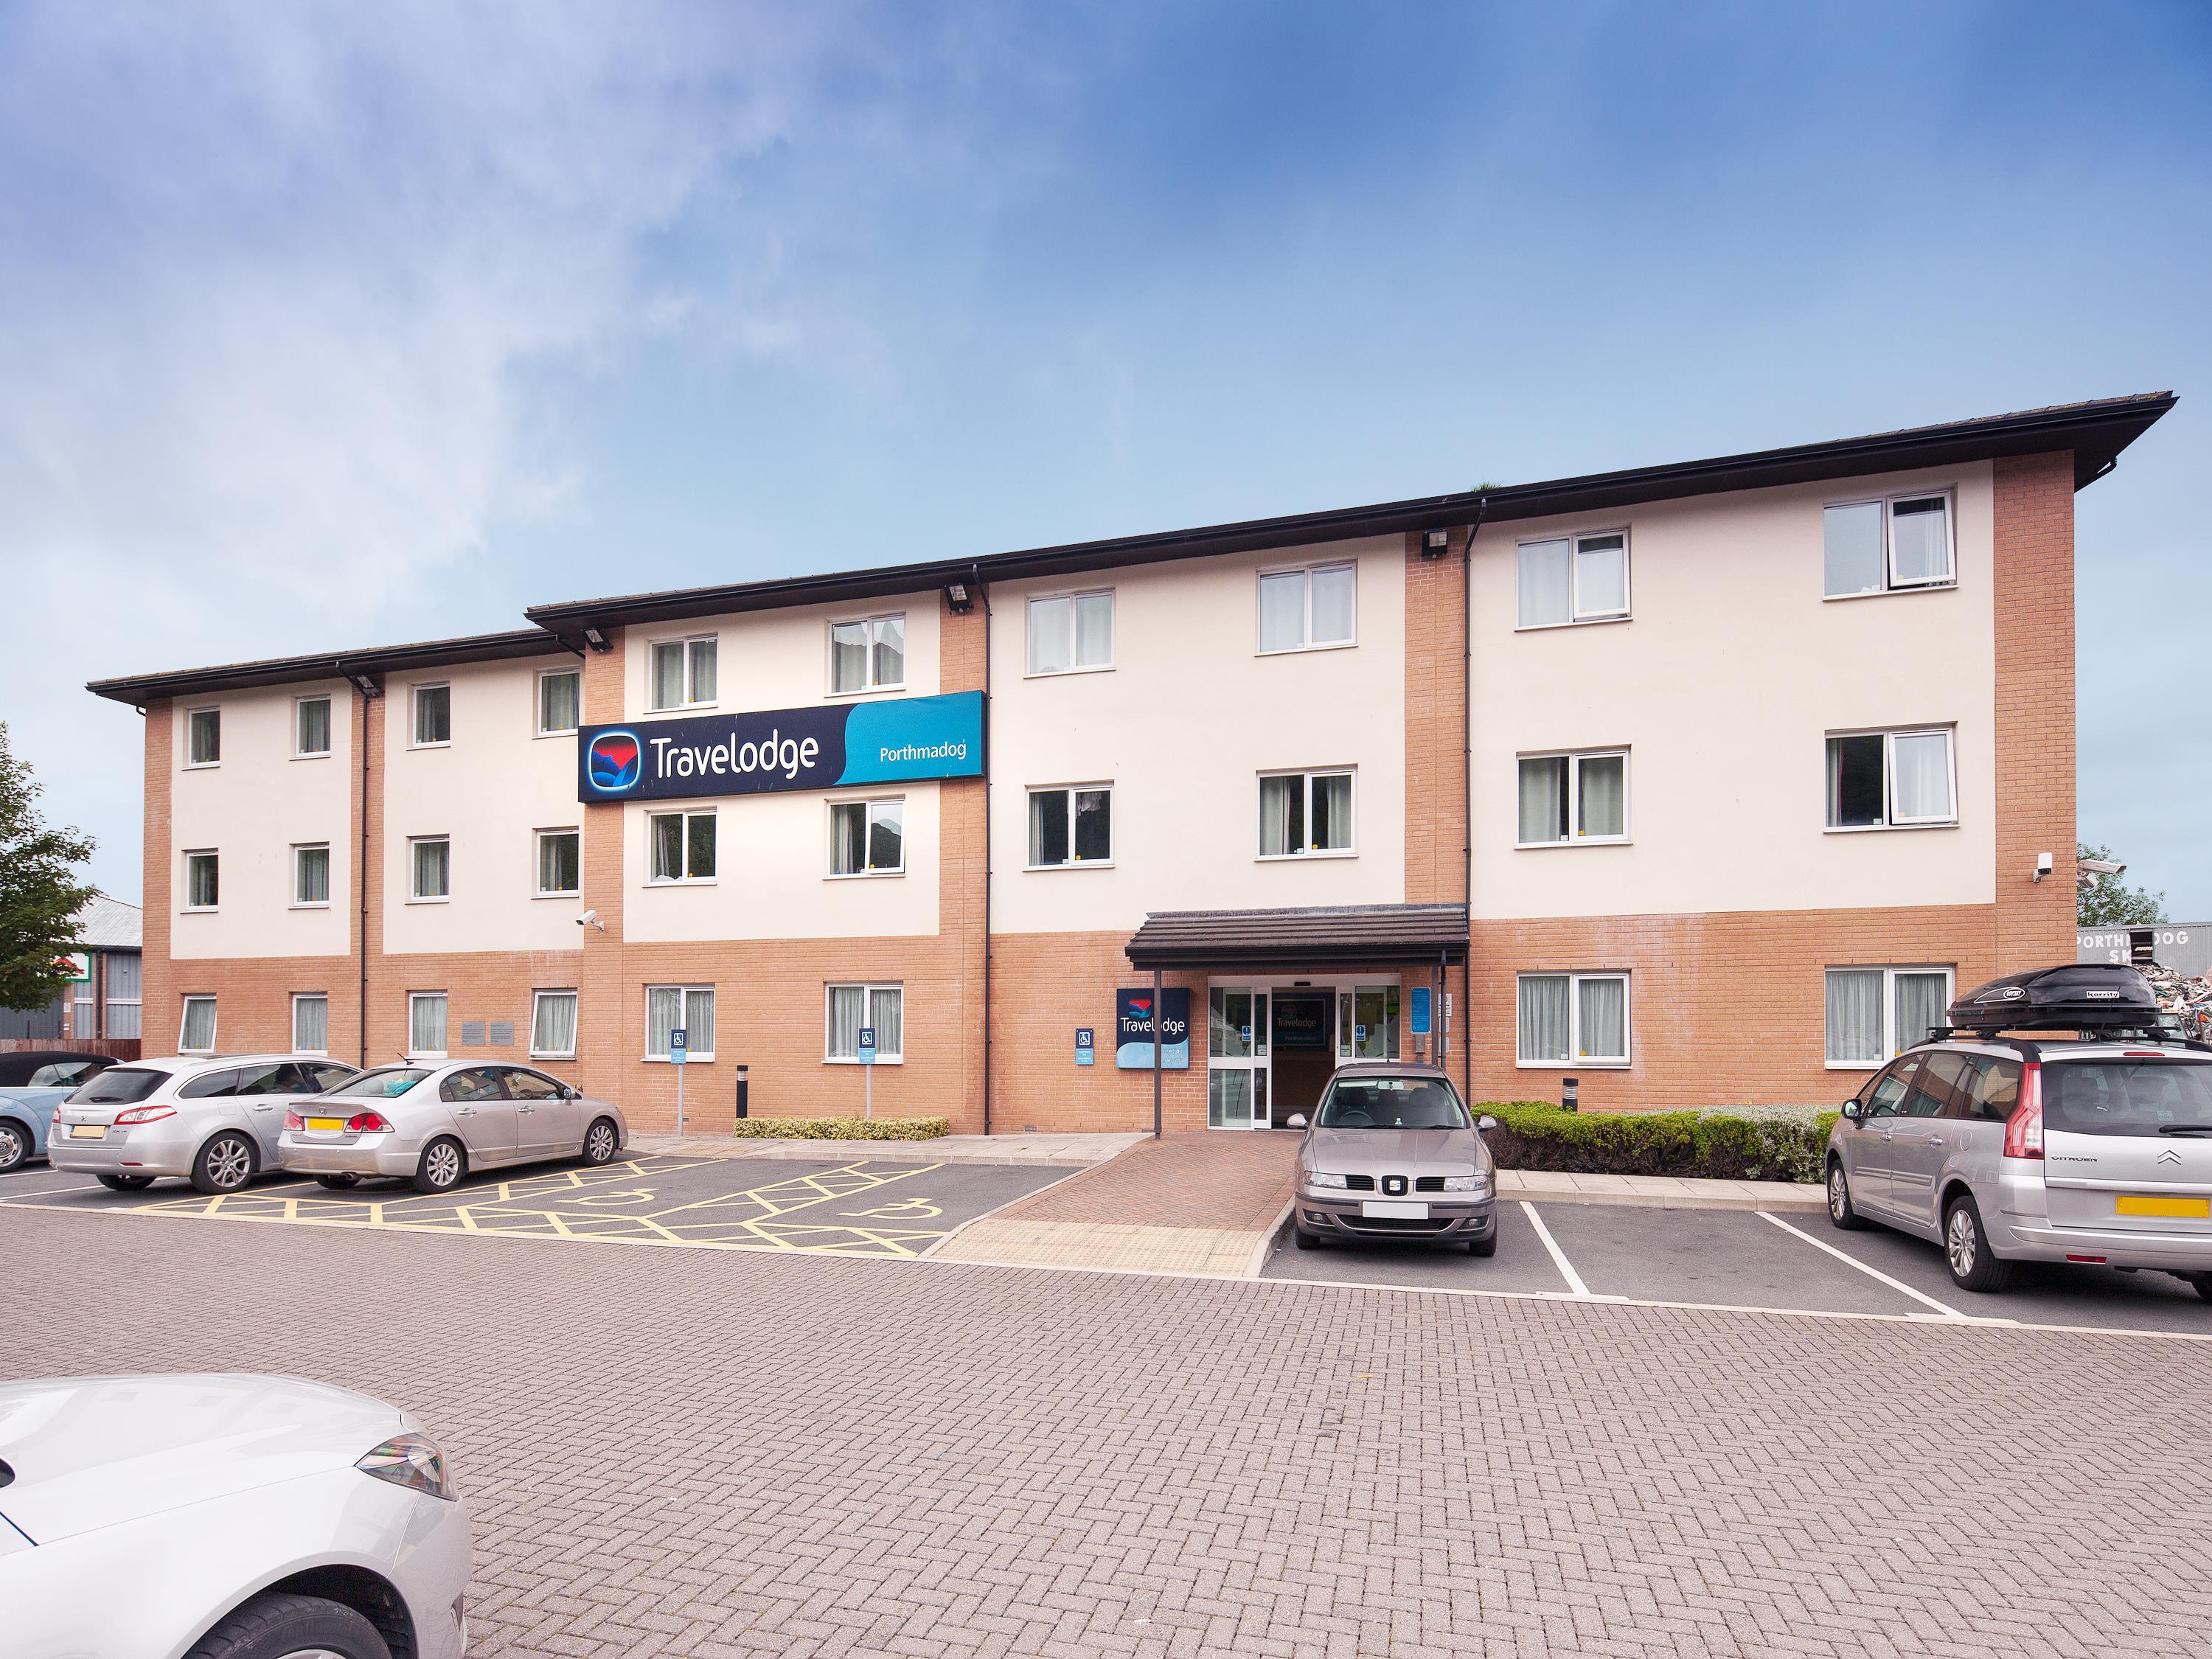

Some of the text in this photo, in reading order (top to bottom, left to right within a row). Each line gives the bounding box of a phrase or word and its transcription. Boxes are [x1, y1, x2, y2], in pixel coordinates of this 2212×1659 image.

[650, 728, 820, 779] Travelodge
[880, 740, 967, 762] Porthmadog
[2109, 949, 2132, 964] SK
[1120, 1017, 1185, 1035] Traveldge
[1276, 1018, 1317, 1029] Travelodge
